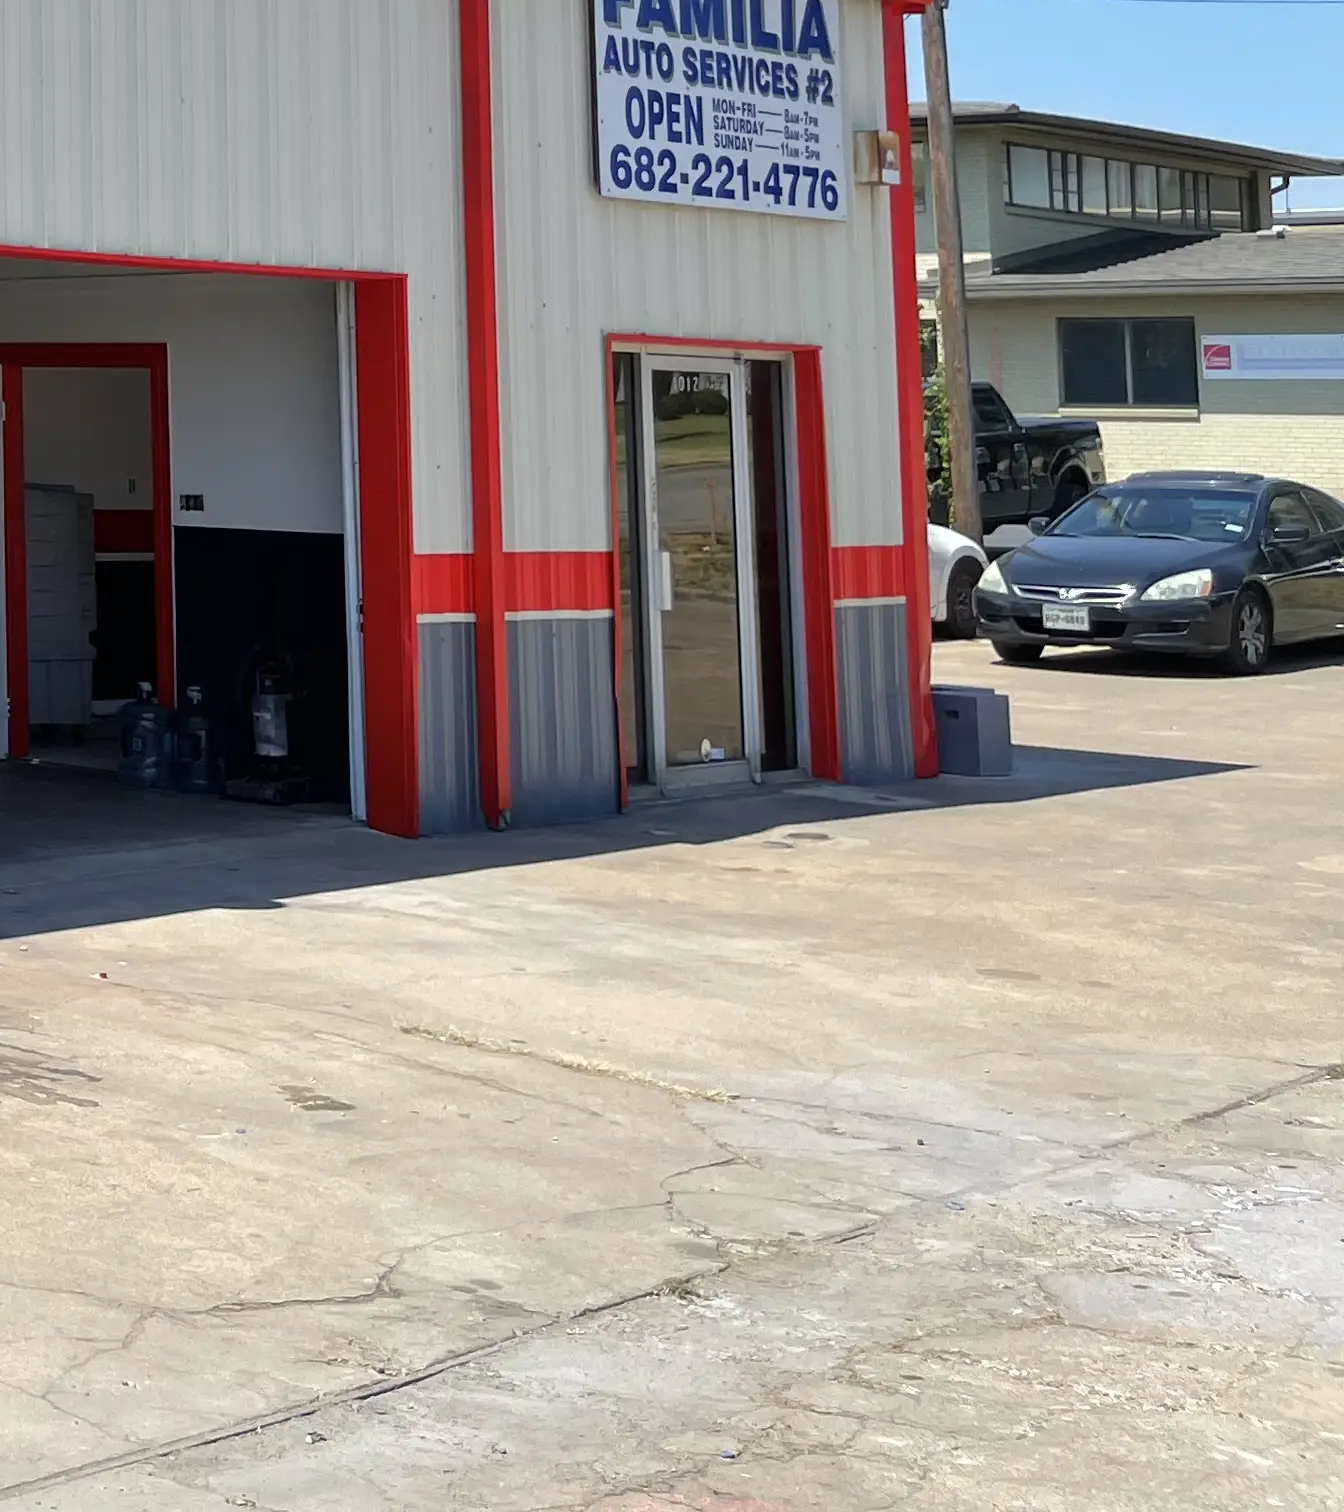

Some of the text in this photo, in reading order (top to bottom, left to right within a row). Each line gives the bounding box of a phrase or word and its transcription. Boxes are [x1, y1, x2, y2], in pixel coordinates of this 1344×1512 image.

[603, 35, 835, 106] AUTO SERVICES #2
[625, 86, 704, 145] OPEN
[712, 98, 756, 118] MON-FRI
[713, 115, 764, 136] SATURDAY
[714, 133, 753, 152] SUNDAY
[610, 144, 839, 211] 682-221-4776
